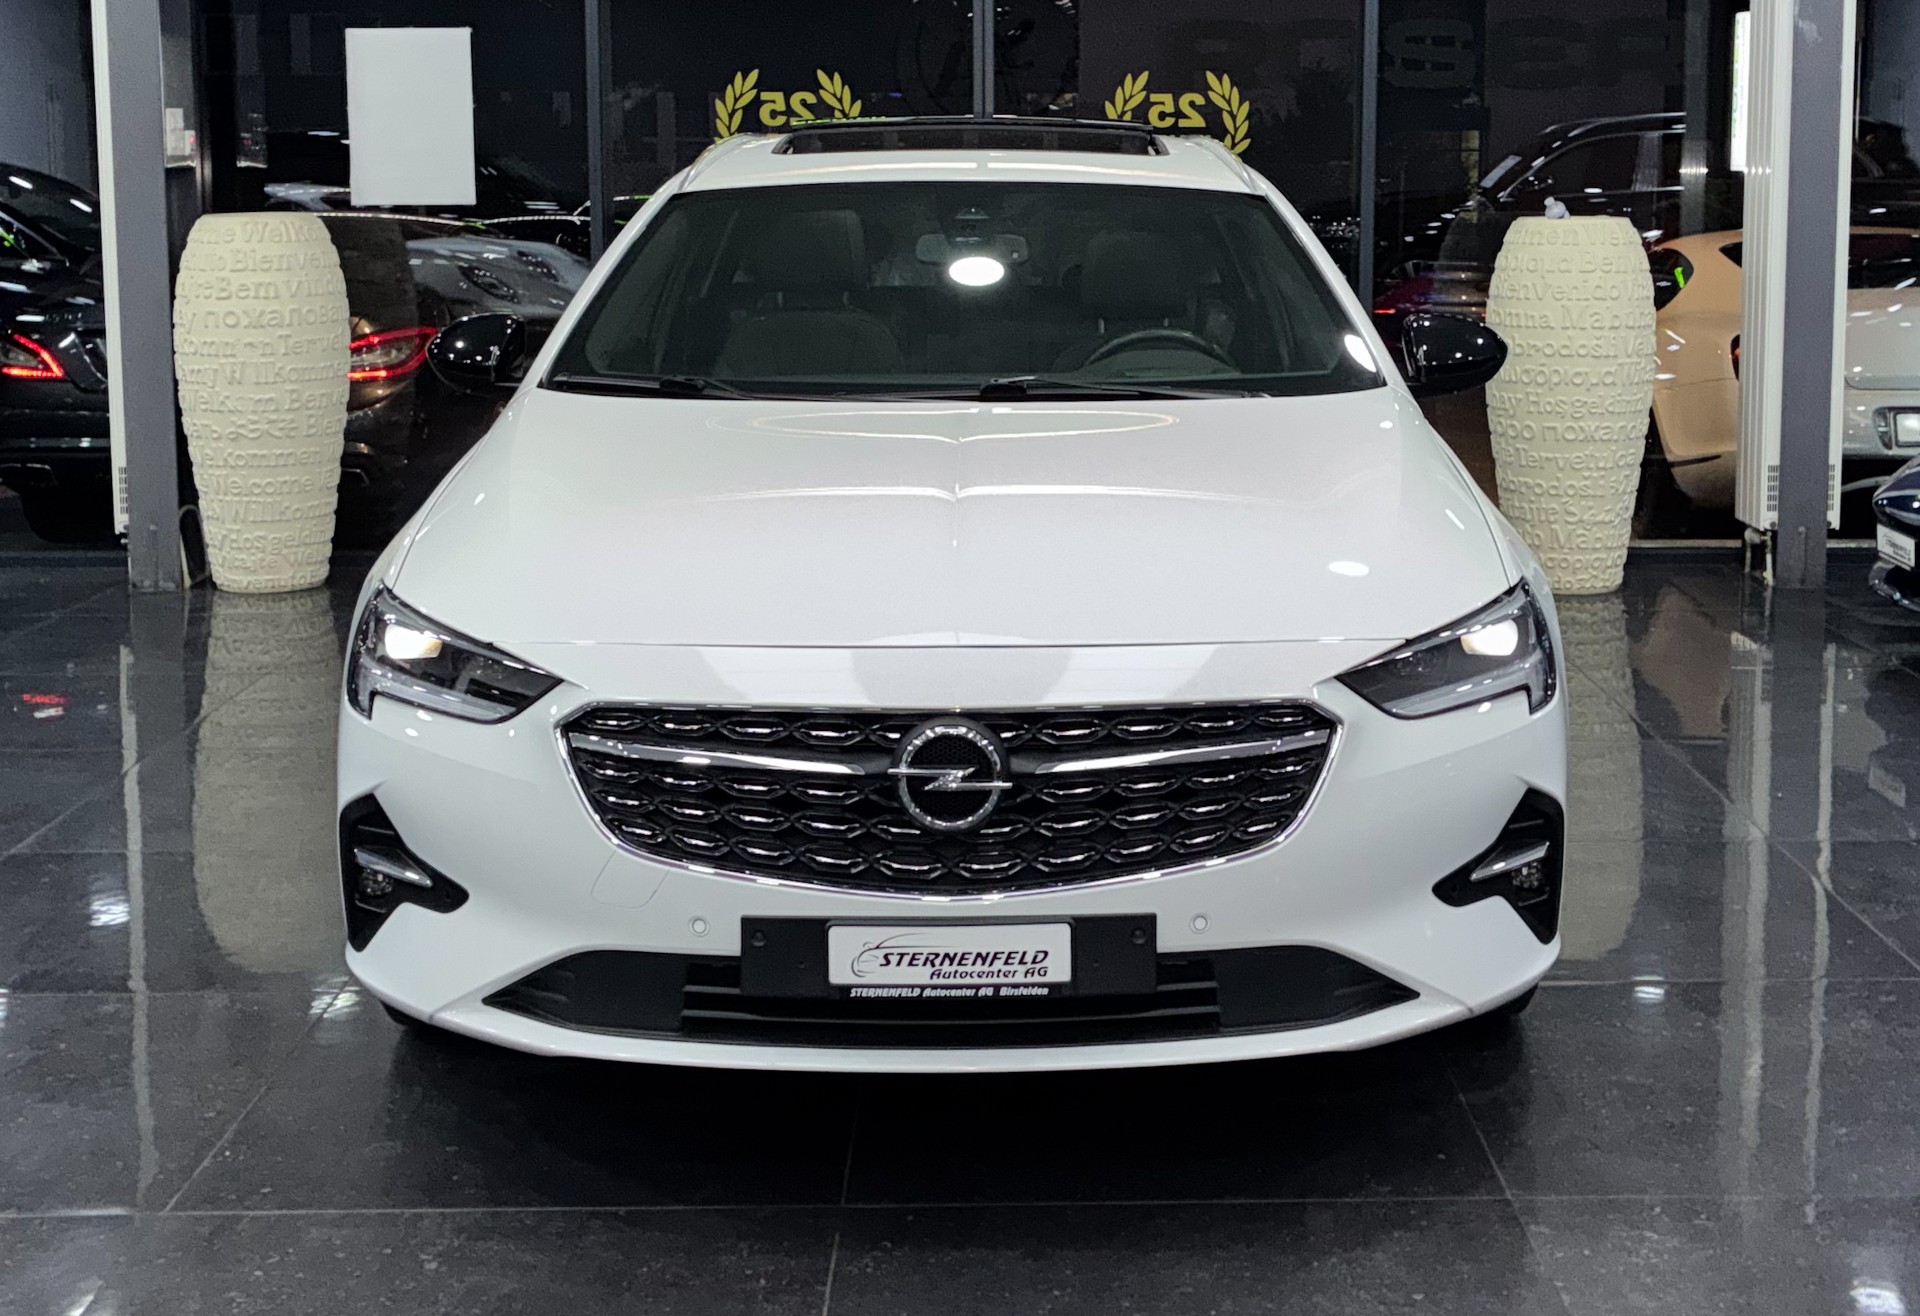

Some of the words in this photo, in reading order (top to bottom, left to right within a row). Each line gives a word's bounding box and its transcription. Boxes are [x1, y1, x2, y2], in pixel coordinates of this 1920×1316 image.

[879, 950, 1049, 968] STERNENFELD
[930, 968, 1019, 981] Autocenter
[1024, 966, 1049, 979] AG
[850, 987, 921, 998] STERNENFELD
[922, 987, 976, 998] Autocenter
[978, 986, 994, 997] AG
